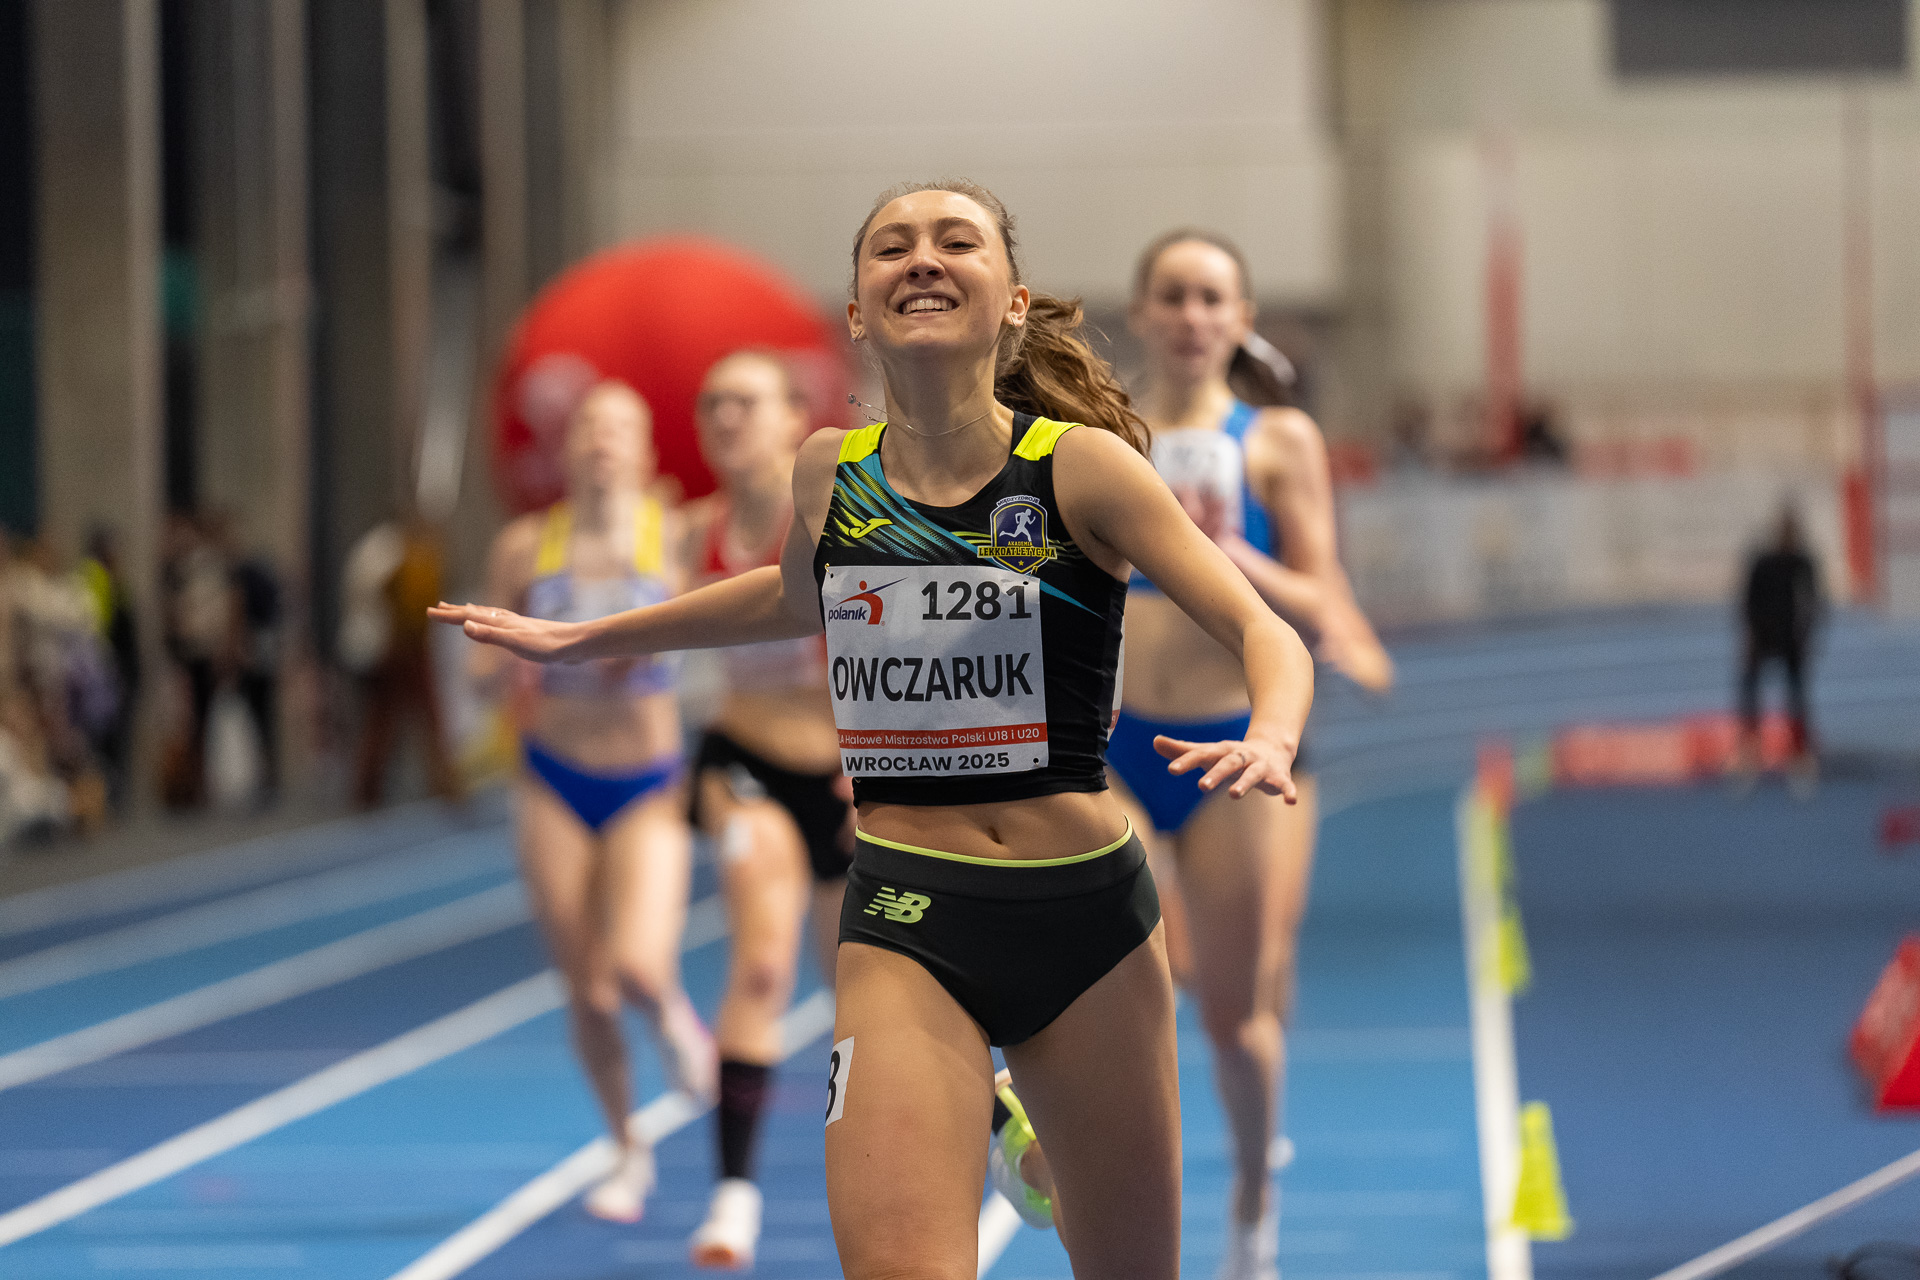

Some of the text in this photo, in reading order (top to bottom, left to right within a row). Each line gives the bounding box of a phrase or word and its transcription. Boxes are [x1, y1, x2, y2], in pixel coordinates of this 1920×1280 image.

[979, 547, 1056, 558] LEKKOATLETYCZNA
[921, 581, 1032, 621] 1281
[828, 606, 868, 623] polanik
[832, 653, 1034, 702] OWCZARUK
[845, 735, 883, 745] Halowe
[885, 735, 949, 745] Mistrzostwa
[952, 732, 986, 744] Polski
[988, 731, 1008, 742] U18
[1017, 728, 1040, 739] U20
[845, 752, 1010, 771] WROCŁAW 2025
